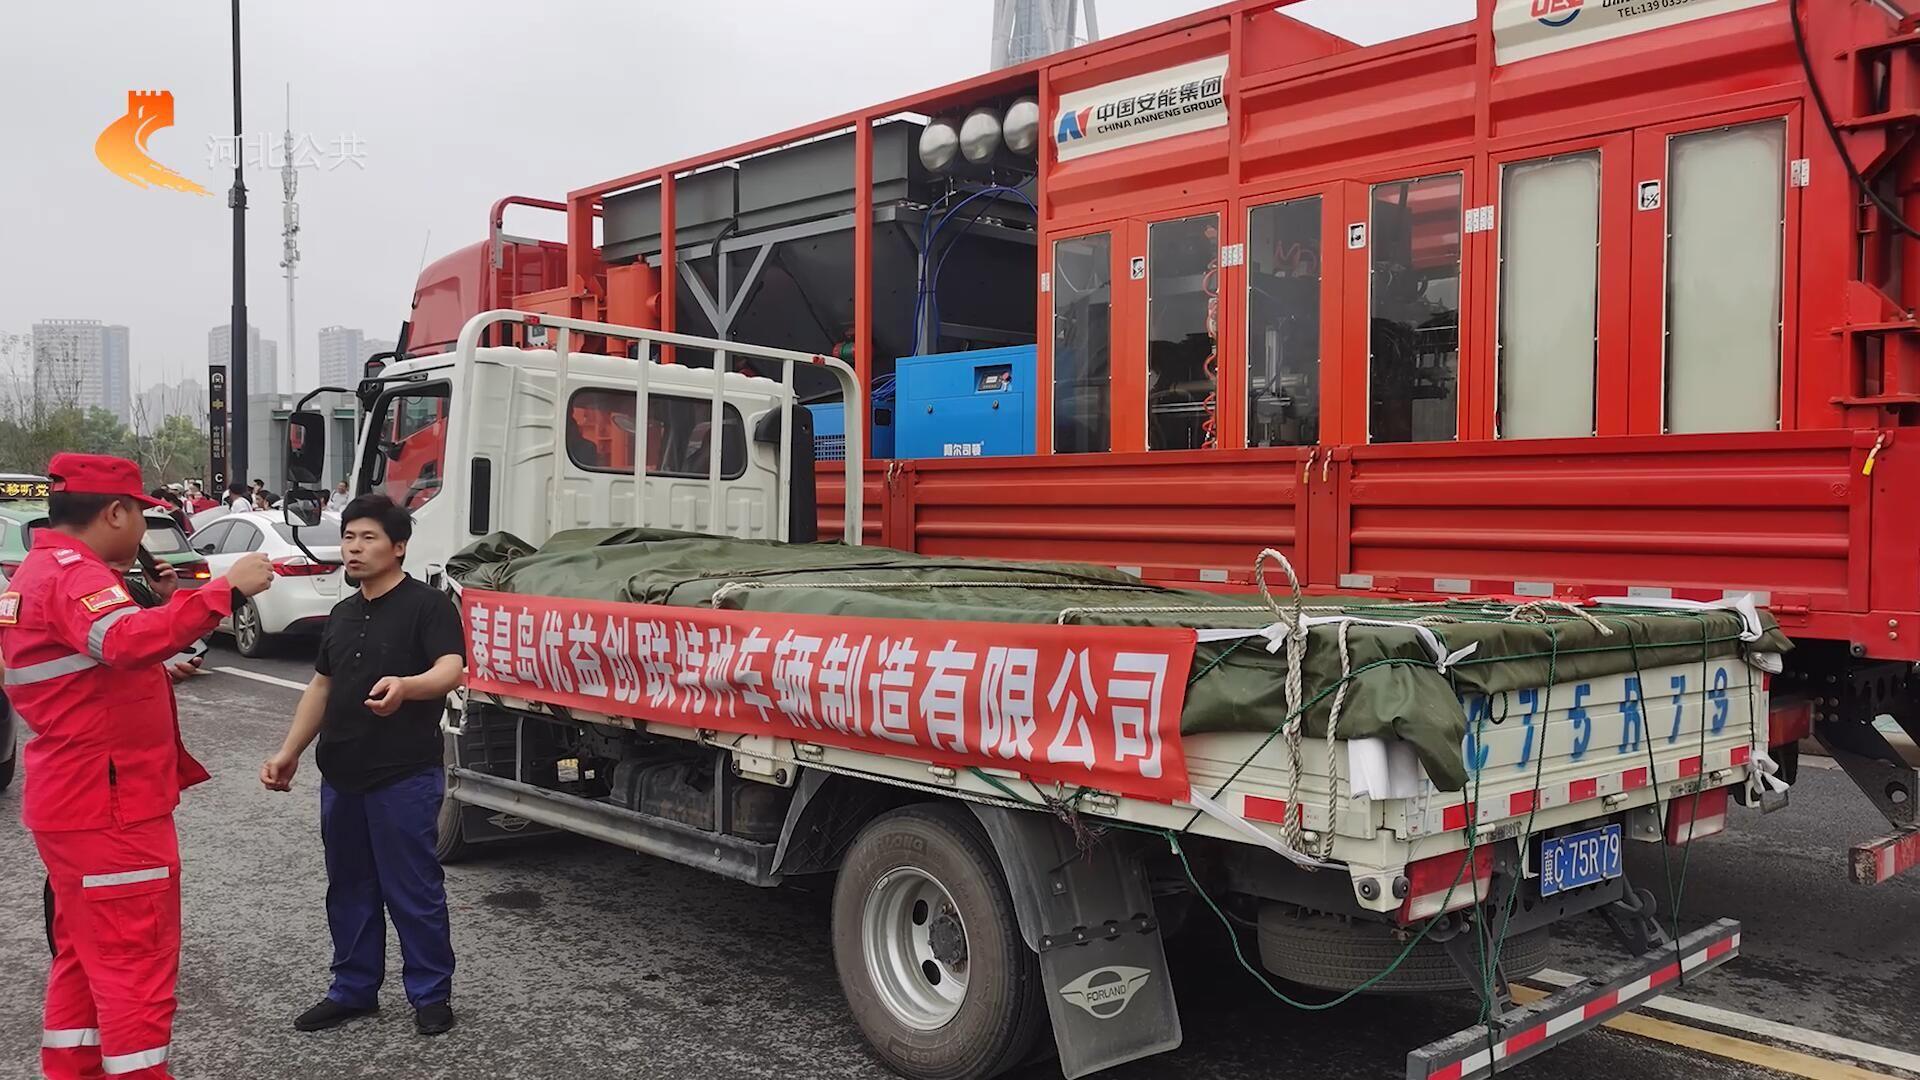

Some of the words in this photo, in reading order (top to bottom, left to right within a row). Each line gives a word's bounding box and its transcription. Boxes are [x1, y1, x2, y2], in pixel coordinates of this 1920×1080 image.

[1096, 74, 1222, 122] 中国安能集团
[1097, 119, 1133, 134] CHINA
[1134, 107, 1181, 126] ANNENG
[1182, 97, 1223, 115] GROUP
[215, 473, 223, 483] C
[469, 601, 1170, 779] 秦皇岛优益创联特种车辆制造有限公司
[1085, 983, 1128, 1005] FORLAND
